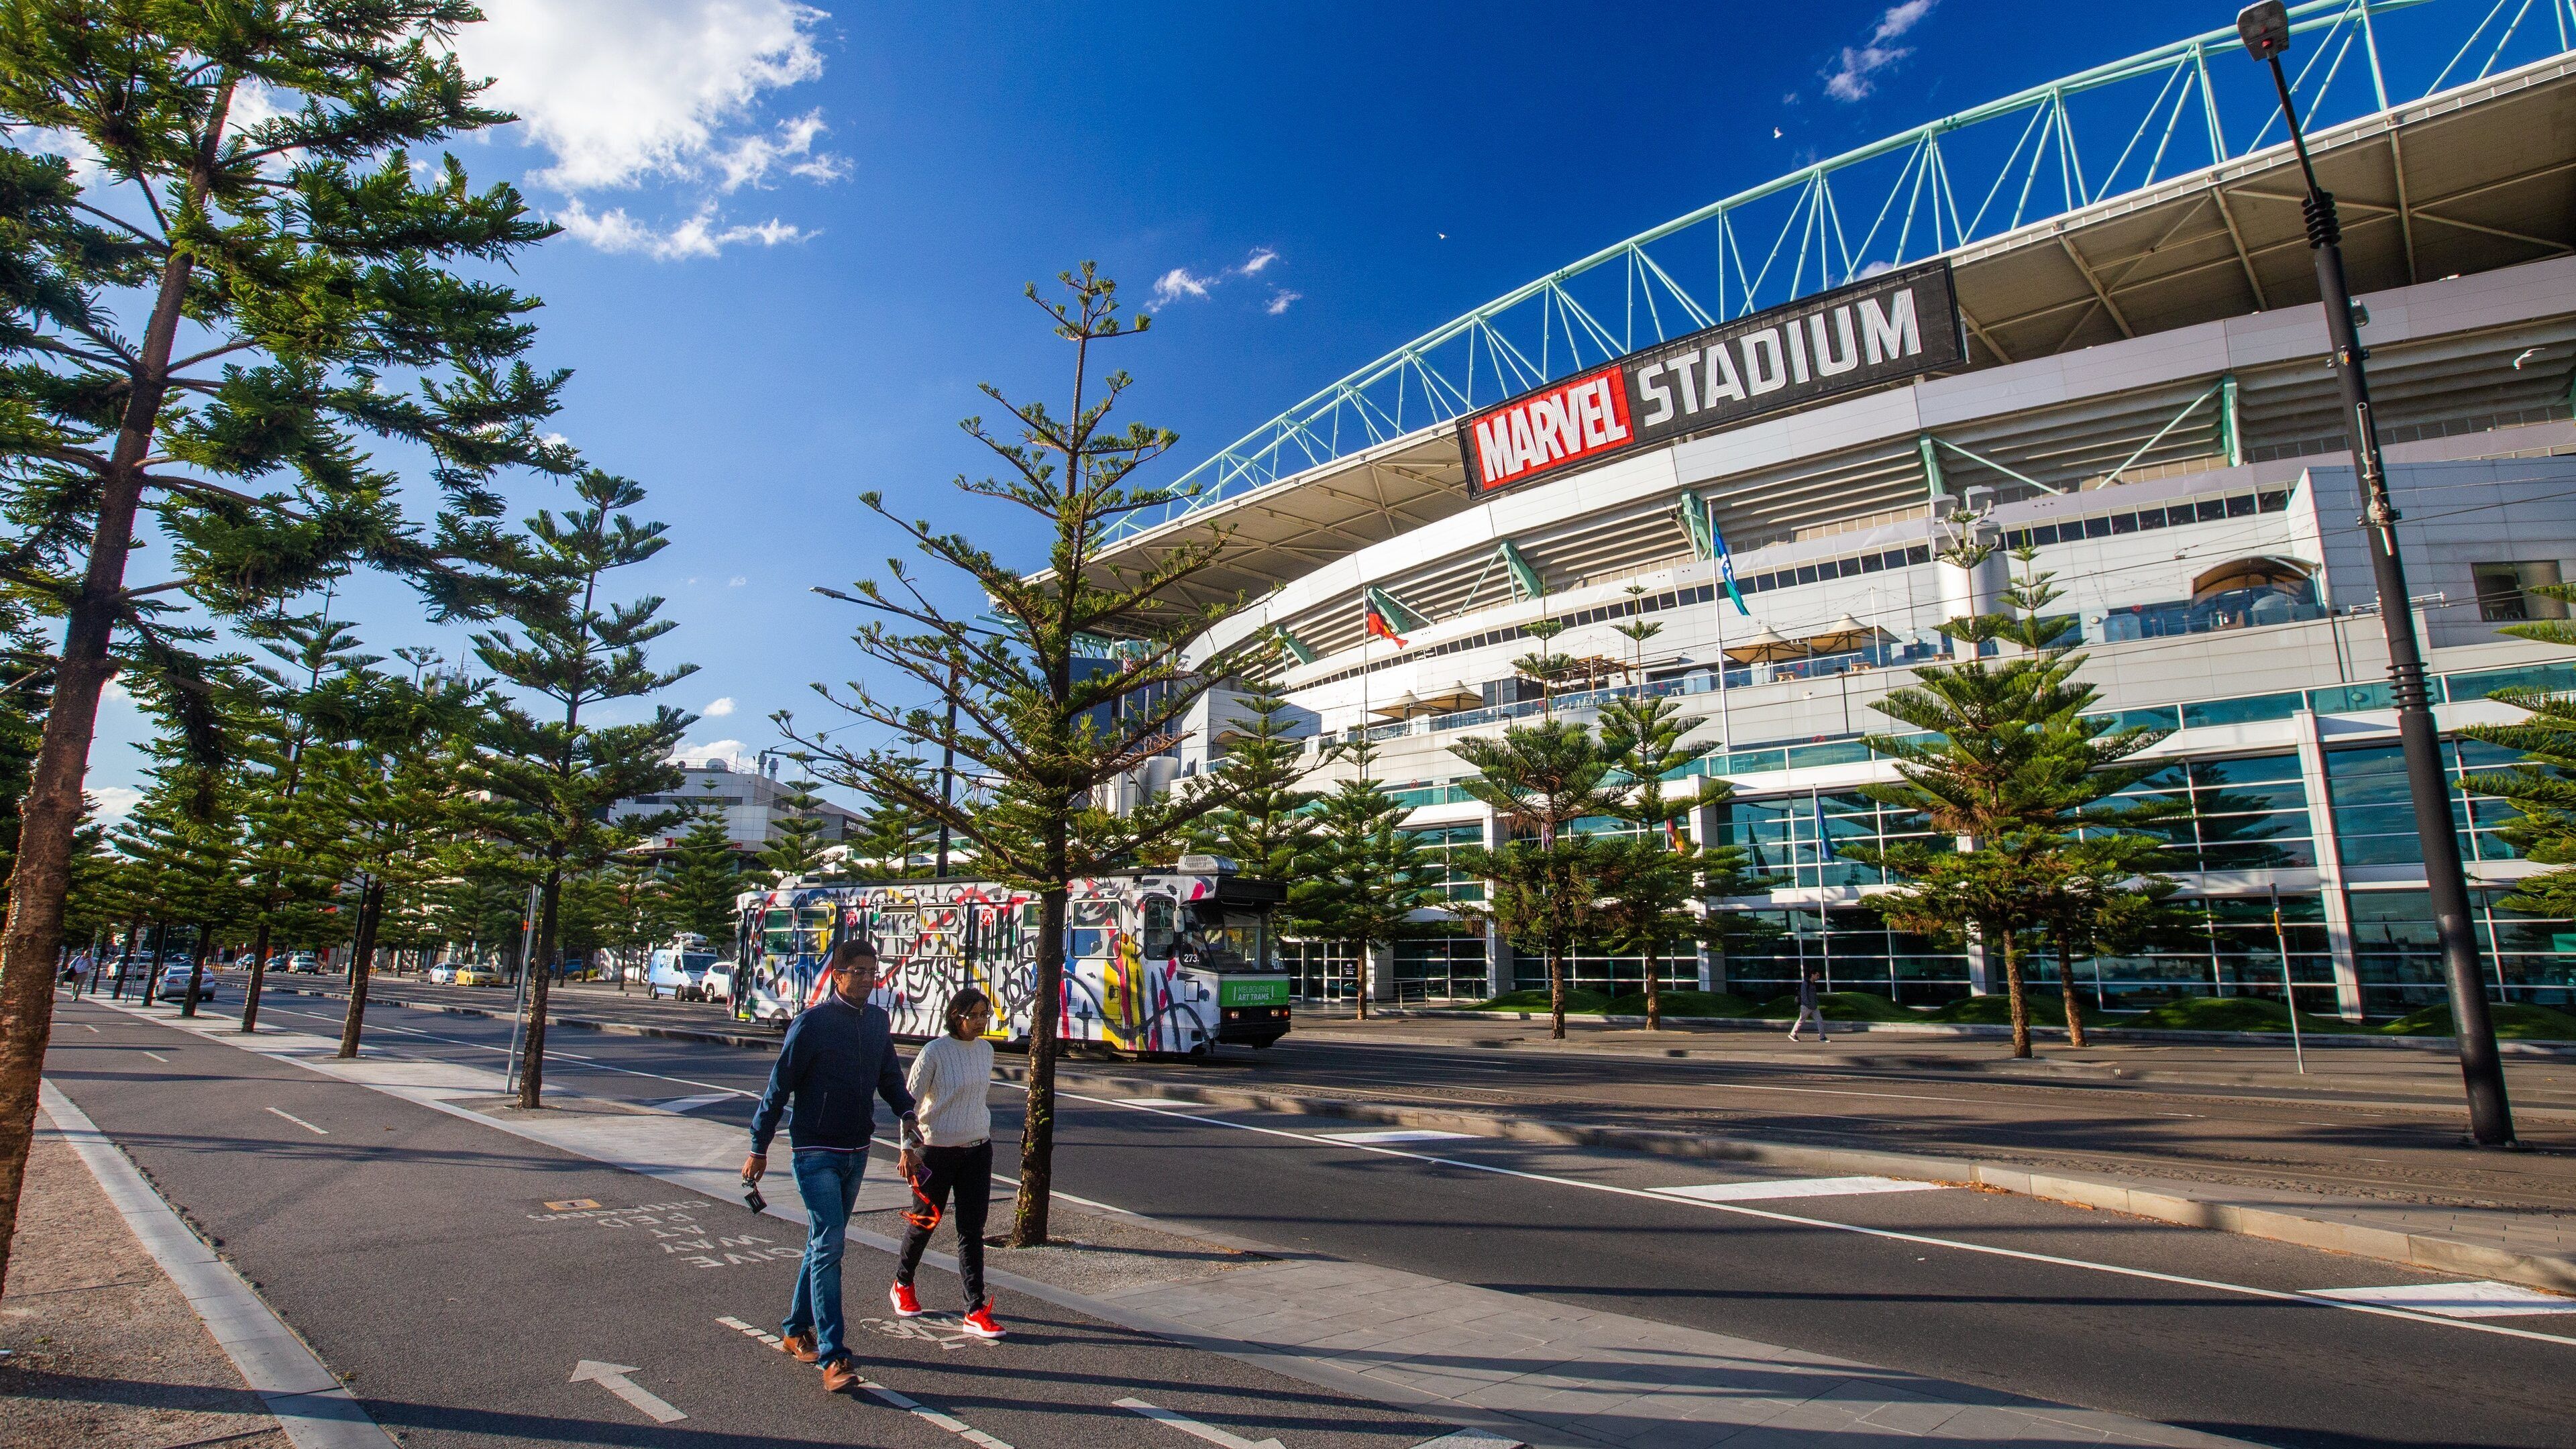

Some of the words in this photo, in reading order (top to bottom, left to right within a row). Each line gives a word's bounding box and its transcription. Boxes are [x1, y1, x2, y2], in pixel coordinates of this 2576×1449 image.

[1476, 375, 1628, 484] MARVEL
[1638, 287, 1923, 427] STADIUM
[846, 820, 857, 832] FOOTY
[1238, 985, 1270, 994] MELBOURNE
[1238, 994, 1250, 1002] ART
[1250, 993, 1270, 1001] TRAMS
[597, 1212, 696, 1228] PED
[649, 1224, 706, 1238] AT
[658, 1234, 775, 1253] WAY
[680, 1247, 805, 1268] GIVE
